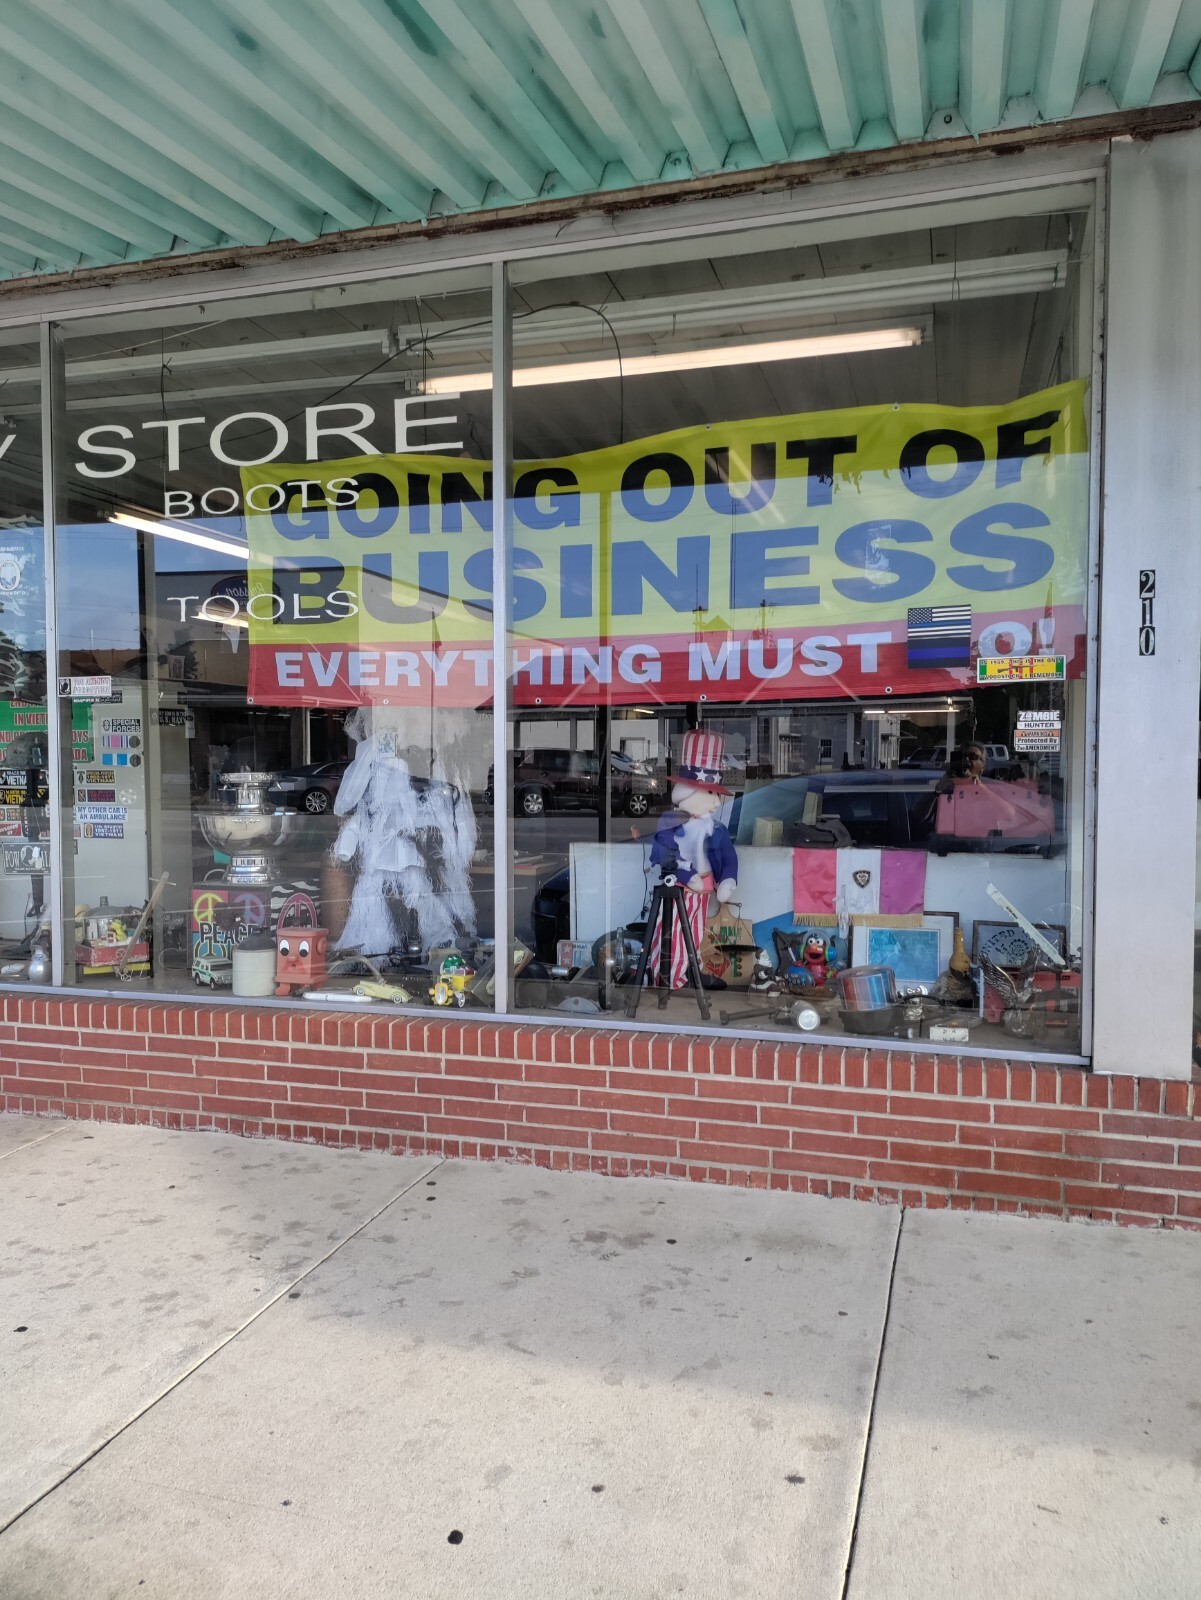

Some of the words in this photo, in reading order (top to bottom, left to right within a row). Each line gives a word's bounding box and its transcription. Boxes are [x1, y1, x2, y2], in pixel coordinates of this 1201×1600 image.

[75, 391, 465, 478] STORE
[164, 477, 360, 518] BOOTS
[268, 467, 581, 541] GOING
[620, 434, 858, 522] OUT
[899, 409, 1062, 499] OF
[272, 502, 1055, 625] BUSINESS
[167, 590, 359, 622] TOOLS
[1139, 569, 1155, 655] 210
[275, 644, 662, 687] EVERYTHING
[688, 631, 893, 682] MUST
[4, 850, 20, 868] POW
